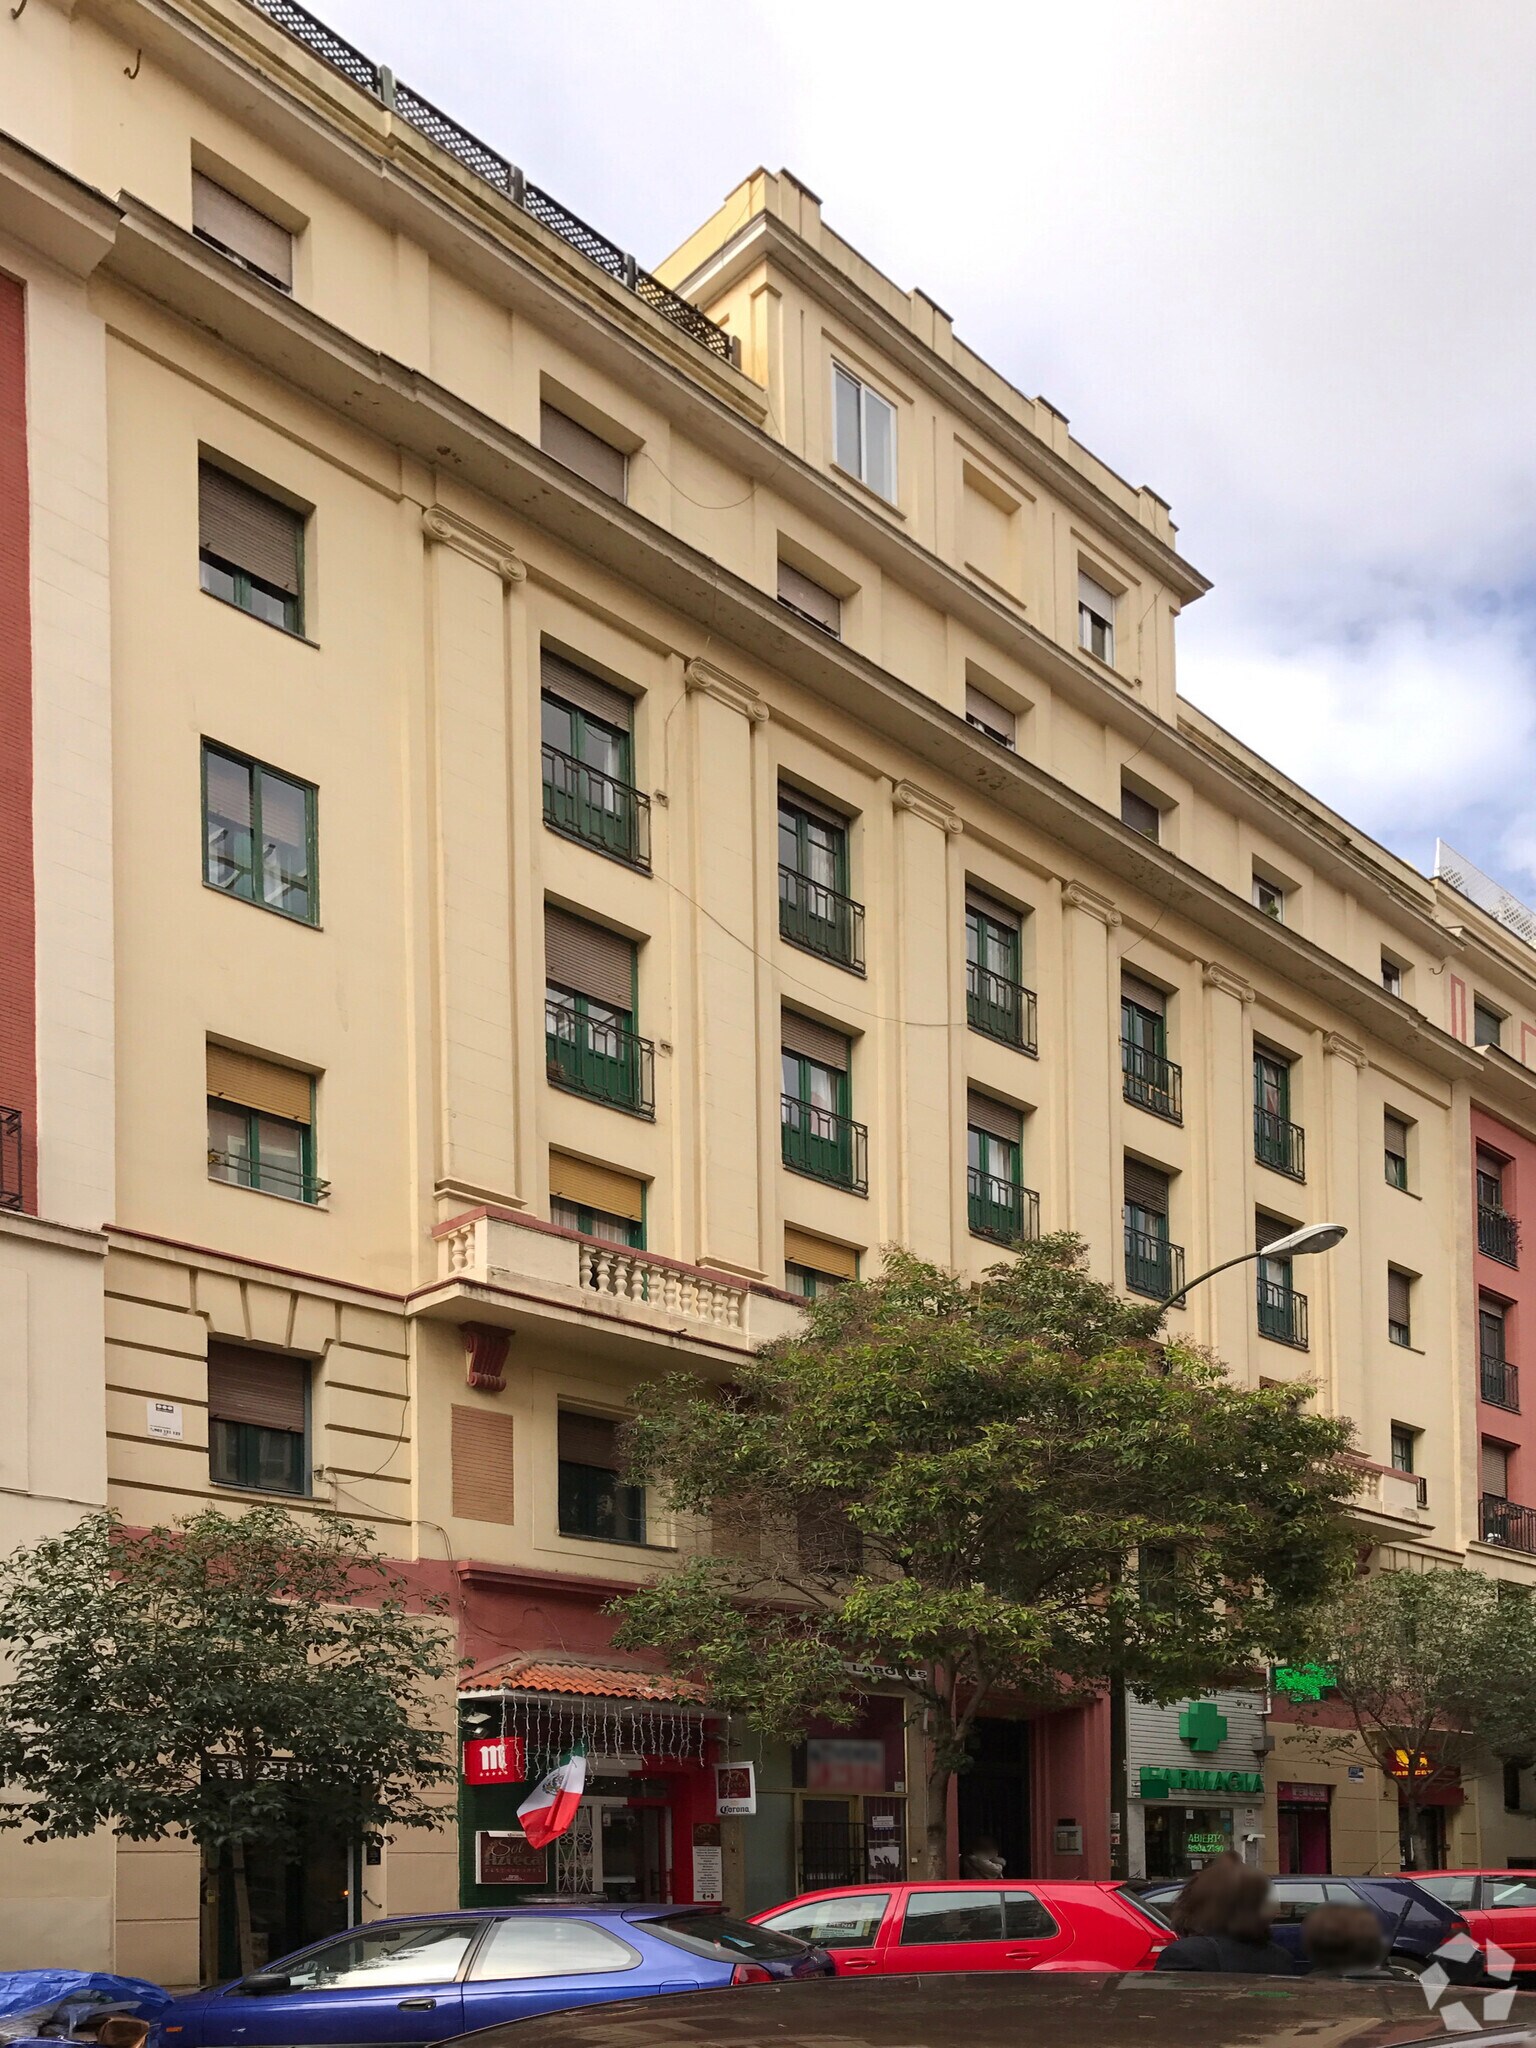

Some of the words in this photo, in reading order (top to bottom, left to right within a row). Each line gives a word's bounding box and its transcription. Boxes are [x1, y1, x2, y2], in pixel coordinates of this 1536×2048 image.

[852, 1664, 927, 1679] LABOES
[1142, 1766, 1265, 1793] FARMACIA
[720, 1805, 751, 1815] Corona
[1187, 1833, 1225, 1843] ABIERTO
